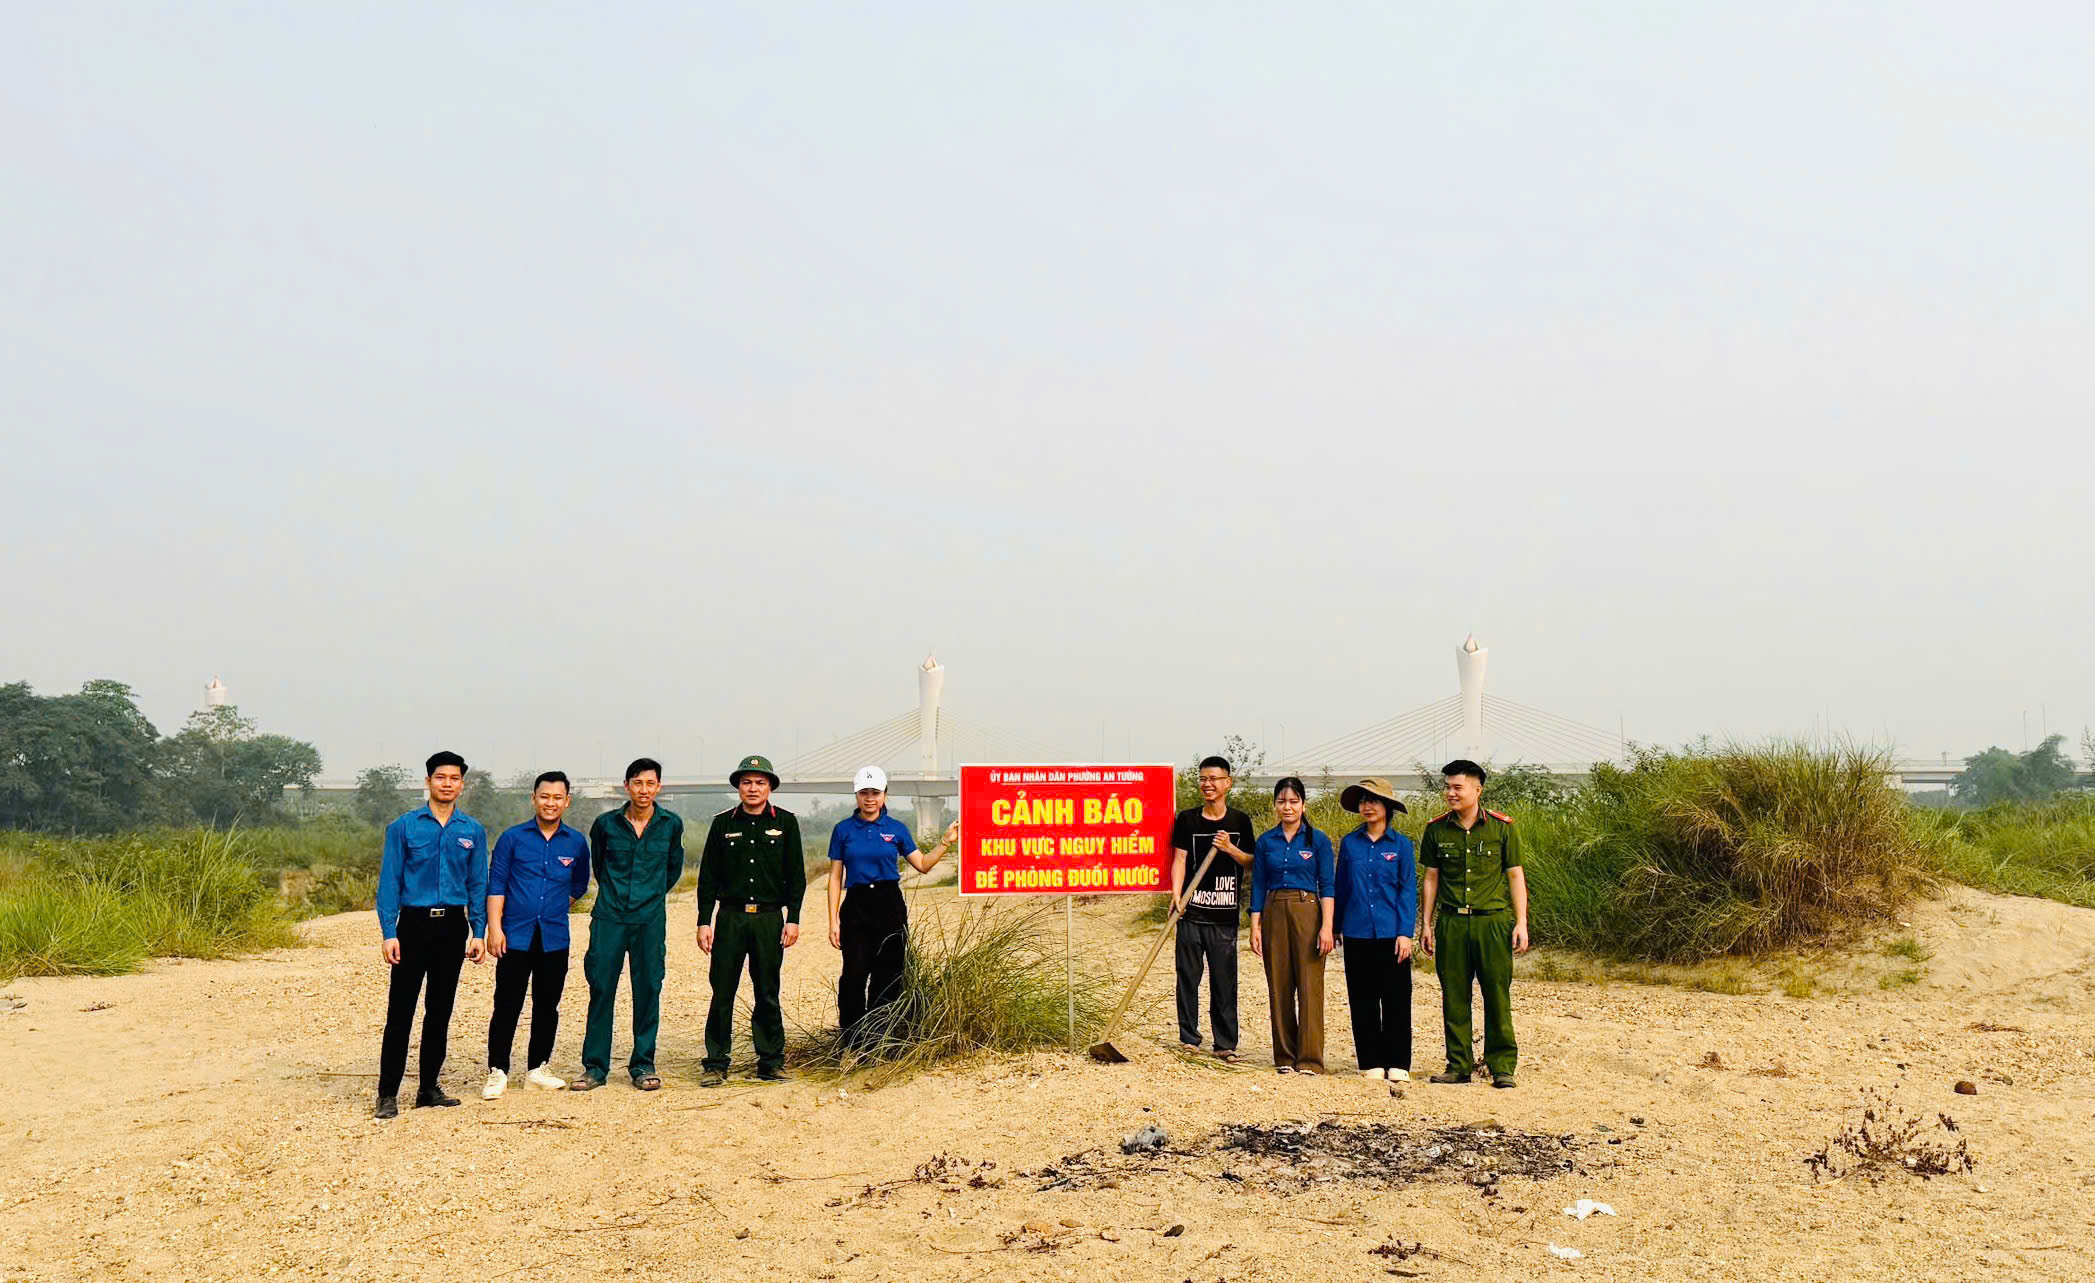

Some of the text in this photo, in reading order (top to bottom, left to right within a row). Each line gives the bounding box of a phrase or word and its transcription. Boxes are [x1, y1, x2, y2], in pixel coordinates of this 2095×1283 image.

[1003, 772, 1021, 782] BAN
[1022, 770, 1047, 782] NHÂN
[1048, 771, 1066, 782] DÂN
[1103, 771, 1115, 781] AN
[991, 790, 1143, 826] CẢNH BÁO
[981, 829, 1155, 860] KHU VỰC NGUY HIỂM
[1003, 866, 1063, 888] PHÒNG
[1068, 862, 1109, 887] ĐUỐI
[1113, 863, 1160, 886] NƯỚC
[1215, 876, 1236, 891] LOVE
